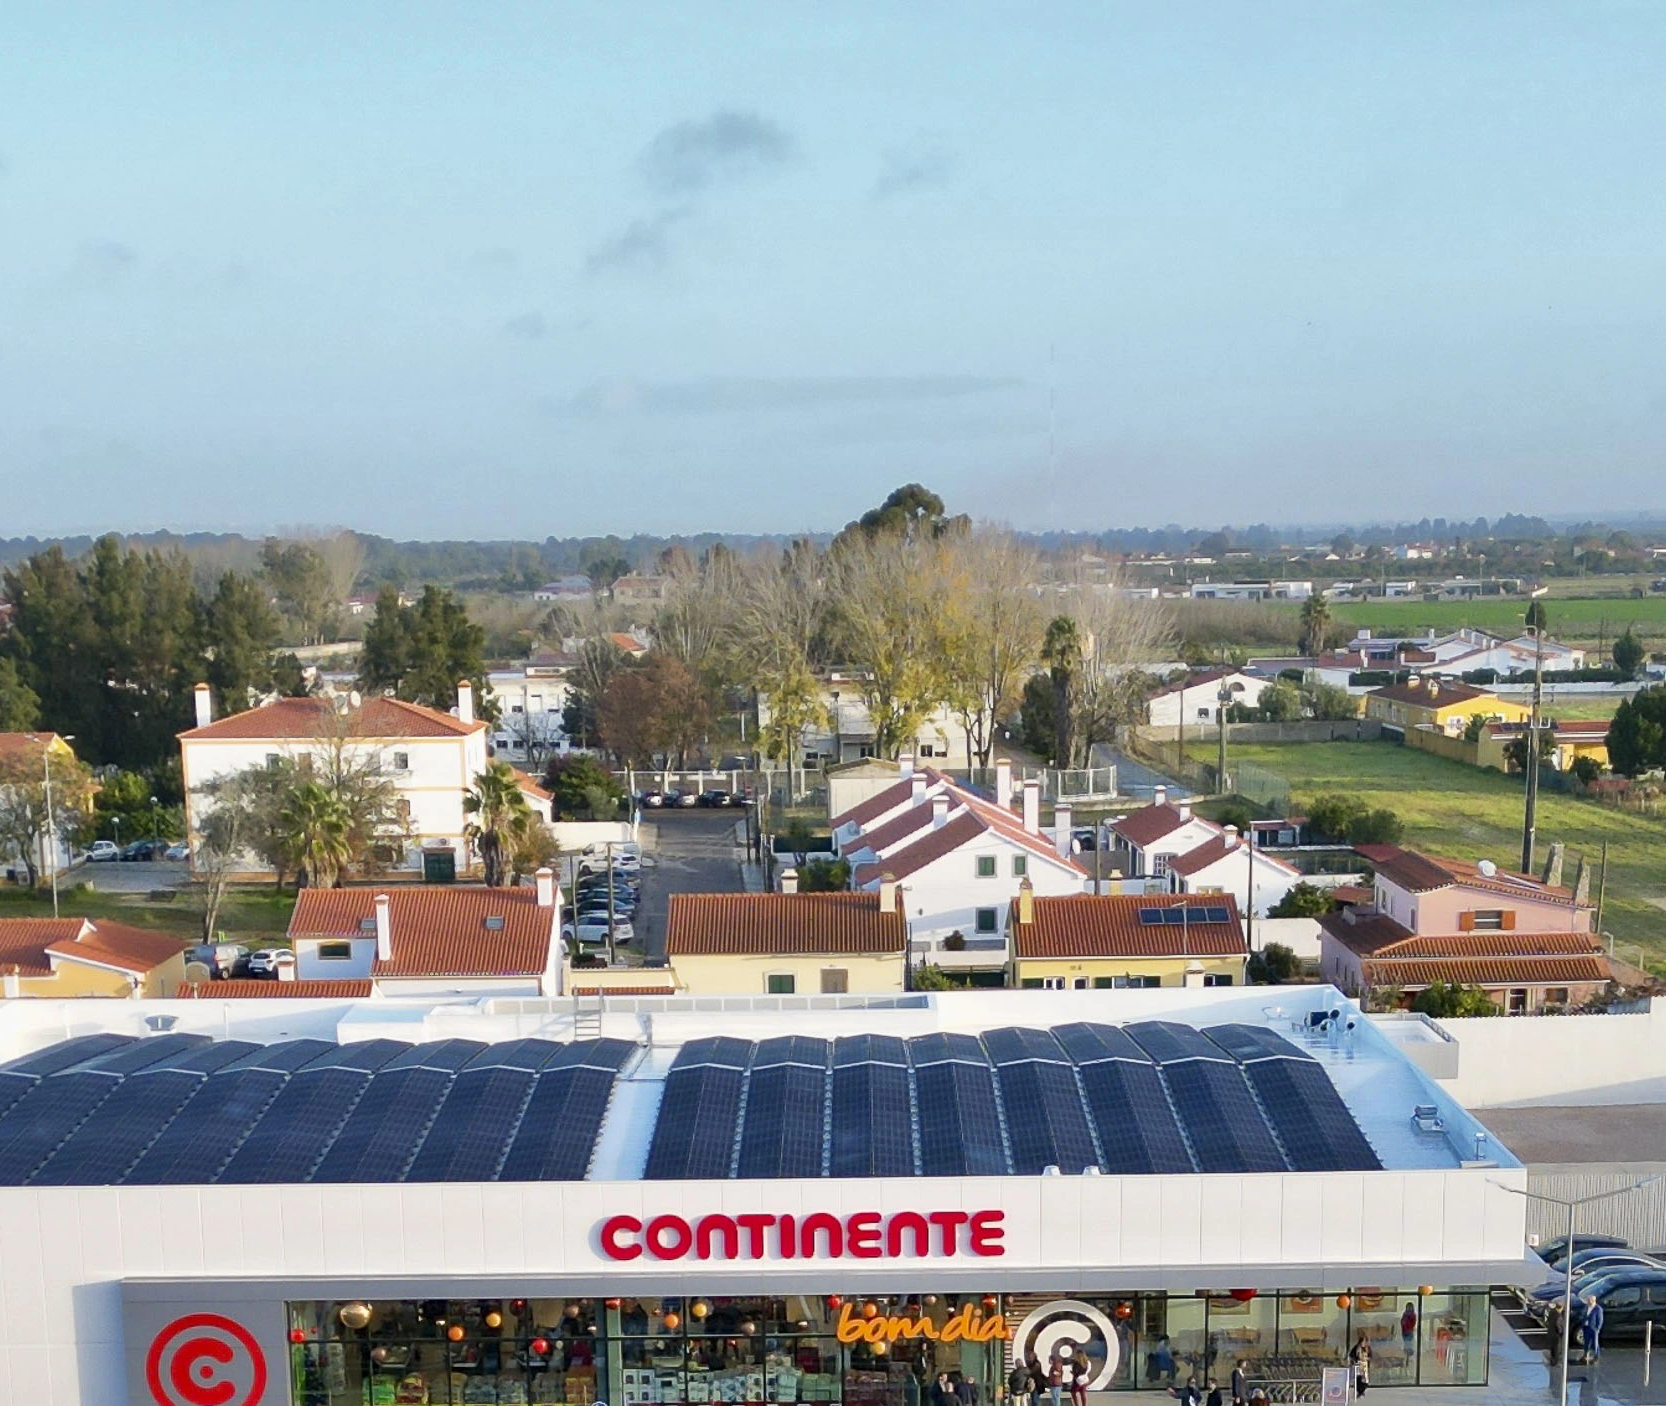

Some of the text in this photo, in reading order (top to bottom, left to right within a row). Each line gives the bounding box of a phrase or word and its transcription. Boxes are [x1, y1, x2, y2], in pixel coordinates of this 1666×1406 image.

[600, 1210, 1005, 1261] CONTINENTE
[837, 1303, 1008, 1343] bom dia
